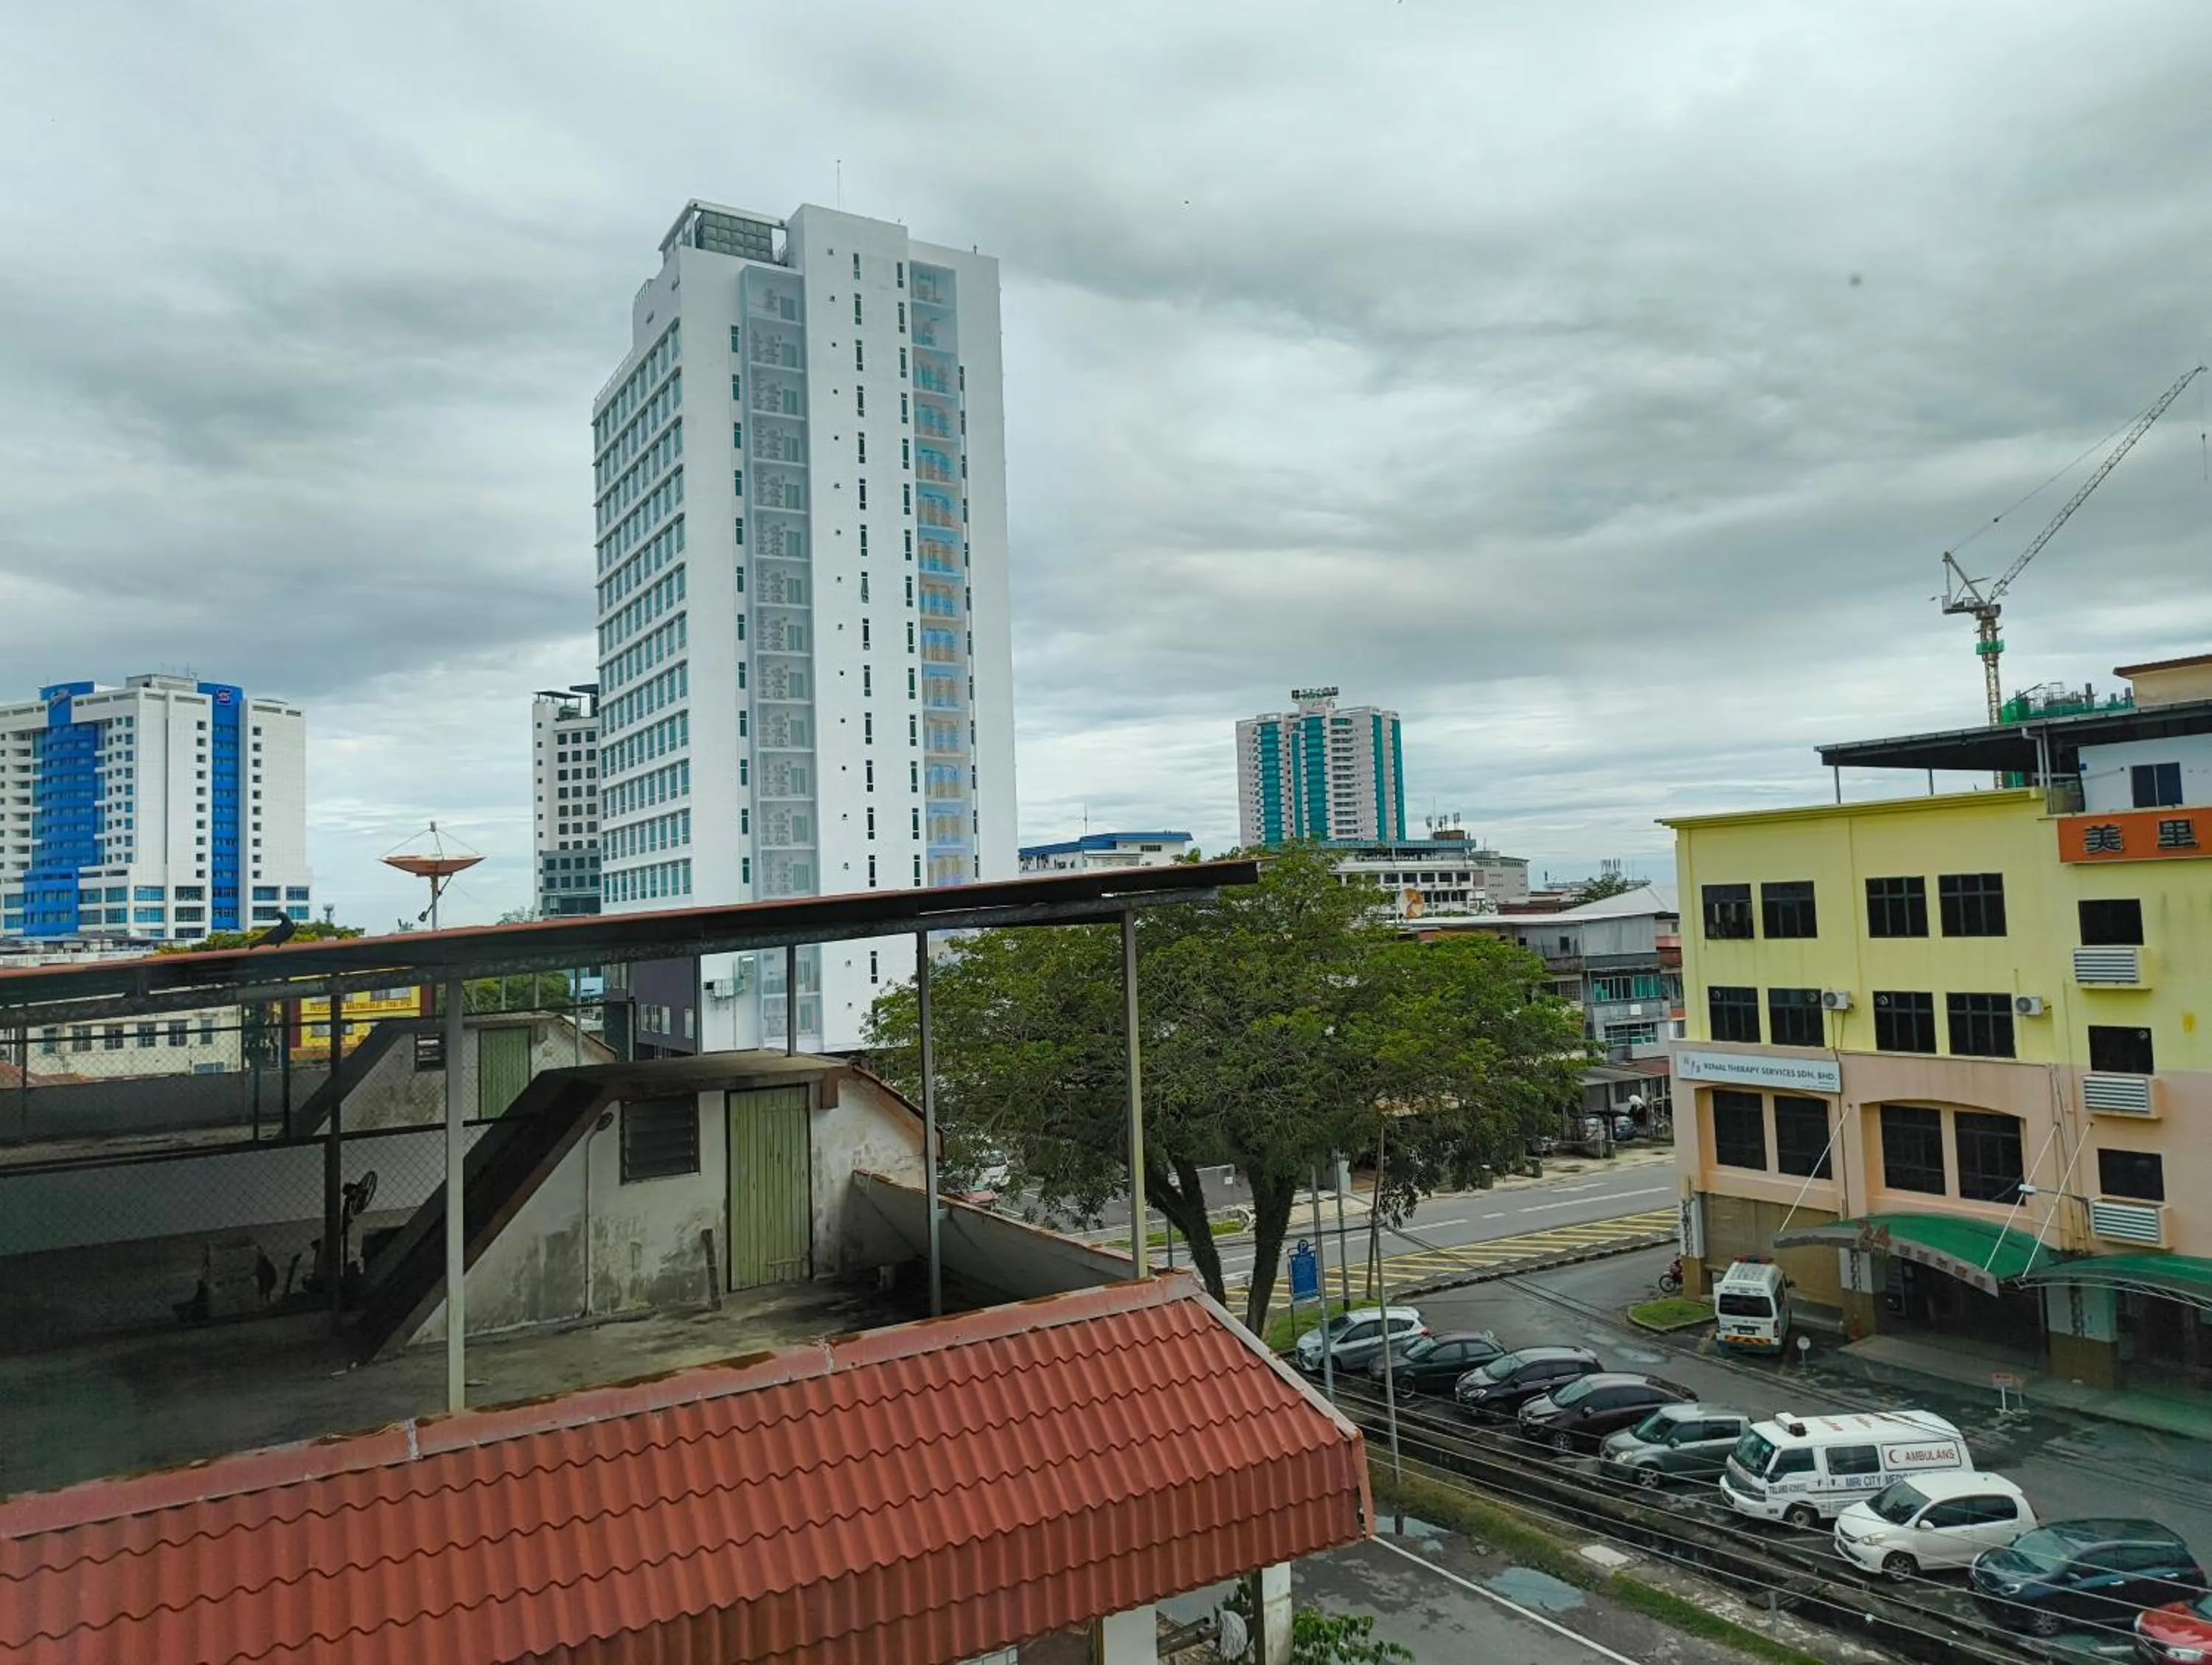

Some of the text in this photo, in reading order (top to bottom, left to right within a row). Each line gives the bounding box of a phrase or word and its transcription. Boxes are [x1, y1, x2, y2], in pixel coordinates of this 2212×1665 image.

[2084, 818, 2200, 854] 美里
[1728, 1064, 1759, 1074] THERAPY
[1761, 1066, 1796, 1077] SERVICES
[1905, 1448, 1955, 1461] AMBULANS
[1863, 1475, 1881, 1487] CITY
